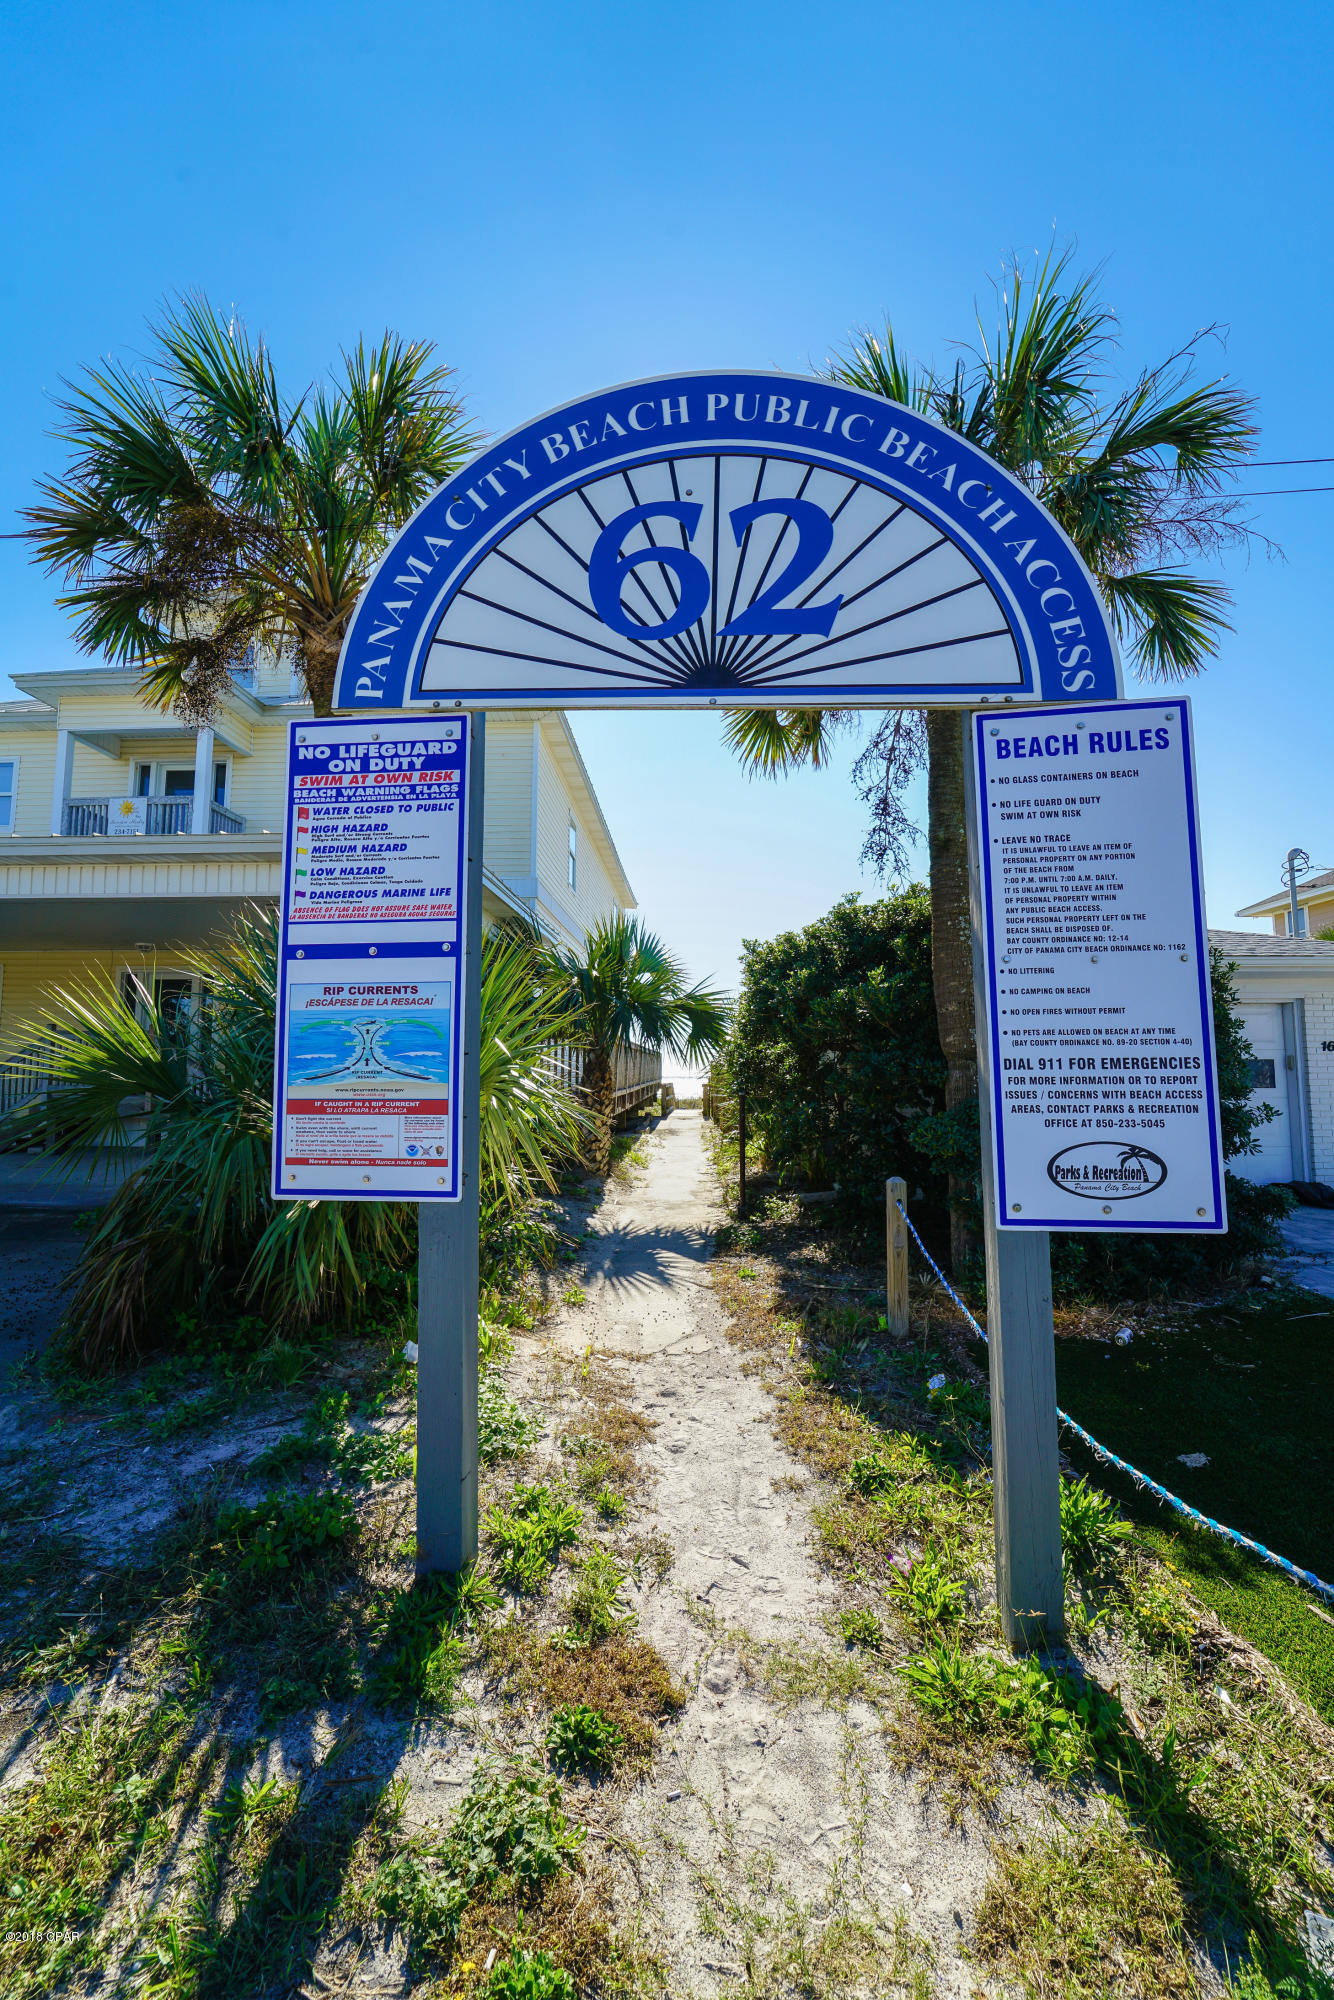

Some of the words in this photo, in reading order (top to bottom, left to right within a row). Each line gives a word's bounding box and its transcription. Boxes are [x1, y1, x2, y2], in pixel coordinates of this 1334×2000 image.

[354, 535, 453, 700] PANAMA
[445, 458, 531, 532] CITY
[540, 395, 691, 464] BEACH
[707, 393, 874, 442] PUBLIC
[878, 427, 1018, 534] BEACH
[1004, 538, 1095, 692] ACCESS
[588, 498, 844, 640] 62
[995, 732, 1078, 760] BEACH
[1088, 727, 1169, 753] RULES
[298, 745, 330, 759] NO
[338, 741, 457, 758] LIFEGUARD
[328, 758, 360, 772] ON
[369, 756, 425, 770] DUTY
[299, 774, 343, 786] SWIM
[348, 773, 369, 785] AT
[373, 772, 413, 784] OWN
[418, 771, 454, 783] RISK
[998, 776, 1009, 784] NO
[1012, 775, 1038, 784] GLASS
[1040, 772, 1093, 782] CONTAINERS
[1096, 771, 1107, 779] ON
[1110, 769, 1138, 778] BEACH
[293, 787, 336, 798] BEACH
[341, 785, 410, 796] WARNING
[415, 783, 459, 794] FLAGS
[999, 800, 1010, 808] NO
[1014, 799, 1031, 808] LIFE
[1034, 798, 1062, 806] GUARD
[1064, 797, 1076, 805] ON
[1079, 796, 1100, 804] DUTY
[312, 805, 349, 815] WATER
[353, 804, 394, 814] CLOSED
[398, 804, 412, 813] TO
[415, 802, 454, 812] PUBLIC
[1000, 812, 1023, 820] SWIM
[1039, 810, 1059, 818] OWN
[1061, 809, 1081, 817] RISK
[310, 824, 338, 833] HIGH
[342, 823, 388, 832] HAZARD
[1001, 836, 1027, 844] LEAVE
[1029, 835, 1041, 843] NO
[1043, 834, 1070, 842] TRACE
[311, 844, 357, 853] MEDIUM
[361, 843, 407, 852] HAZARD
[310, 867, 336, 876] LOW
[339, 866, 385, 875] HAZARD
[1029, 865, 1052, 873] BEACH
[308, 889, 377, 899] DANGEROUS
[380, 887, 426, 898] MARINE
[429, 887, 451, 896] LIFE
[323, 986, 344, 996] RIP
[348, 984, 417, 995] CURRENTS
[1003, 1058, 1033, 1070] DIAL
[1038, 1058, 1061, 1070] 911
[1069, 1057, 1095, 1069] FOR
[1101, 1056, 1200, 1069] EMERGENCIES
[1007, 1076, 1025, 1084] FOR
[1029, 1076, 1056, 1084] MORE
[1059, 1076, 1124, 1084] INFORMATION
[1128, 1076, 1141, 1084] OR
[1144, 1075, 1156, 1084] TO
[1160, 1075, 1197, 1084] REPORT
[1005, 1090, 1037, 1099] ISSUES
[1047, 1090, 1098, 1099] CONCERNS
[1101, 1090, 1126, 1098] WITH
[1129, 1090, 1161, 1099] BEACH
[1165, 1090, 1202, 1099] ACCESS
[1011, 1104, 1043, 1114] AREAS,
[1047, 1104, 1090, 1113] CONTACT
[1093, 1104, 1124, 1113] PARKS
[1128, 1104, 1134, 1113] &
[1138, 1104, 1198, 1113] RECREATION
[1044, 1118, 1077, 1127] OFFICE
[1081, 1119, 1092, 1127] AT
[1095, 1118, 1165, 1127] 850-233-5045
[1054, 1164, 1080, 1180] Parks
[1082, 1165, 1089, 1180] &
[1091, 1165, 1142, 1180] Recreation
[1073, 1182, 1101, 1191] Panama
[1104, 1182, 1119, 1191] City
[1121, 1183, 1141, 1192] Beach
